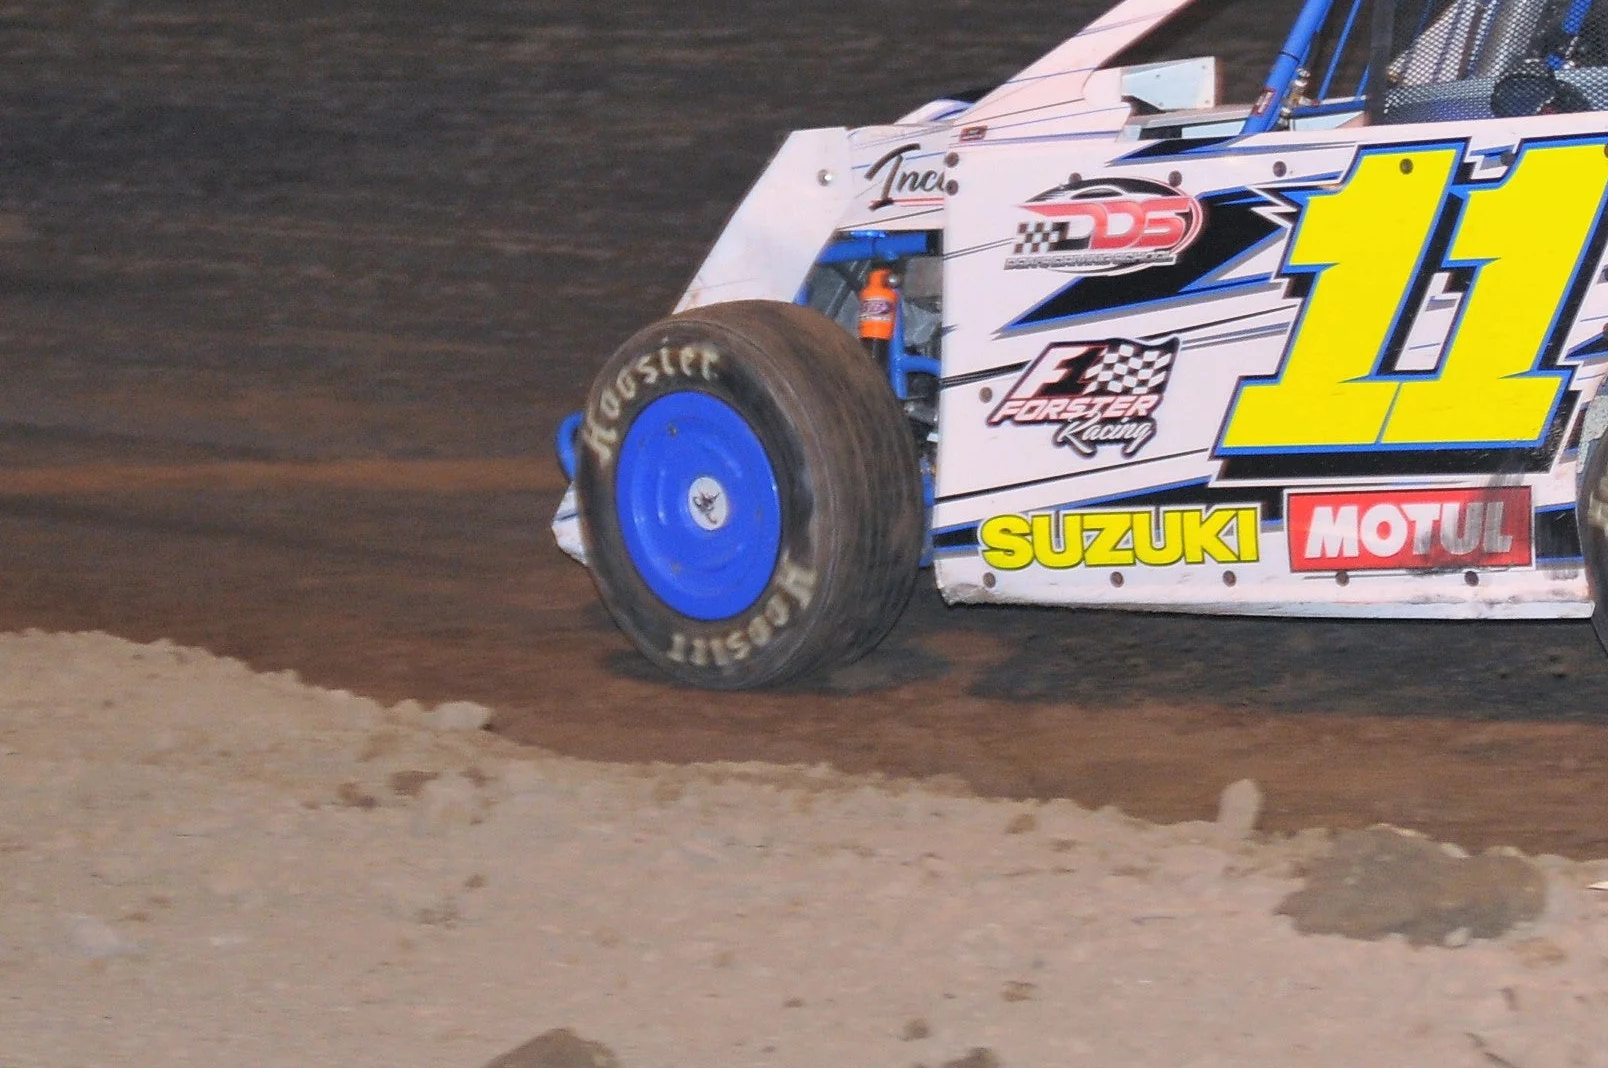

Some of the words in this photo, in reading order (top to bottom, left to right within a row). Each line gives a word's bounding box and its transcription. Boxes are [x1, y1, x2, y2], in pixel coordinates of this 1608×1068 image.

[1018, 196, 1192, 250] DDS
[987, 394, 1160, 423] FORSTER
[1057, 412, 1152, 454] Racing
[982, 508, 1259, 569] SUZUKI
[1305, 500, 1512, 558] MOTUL
